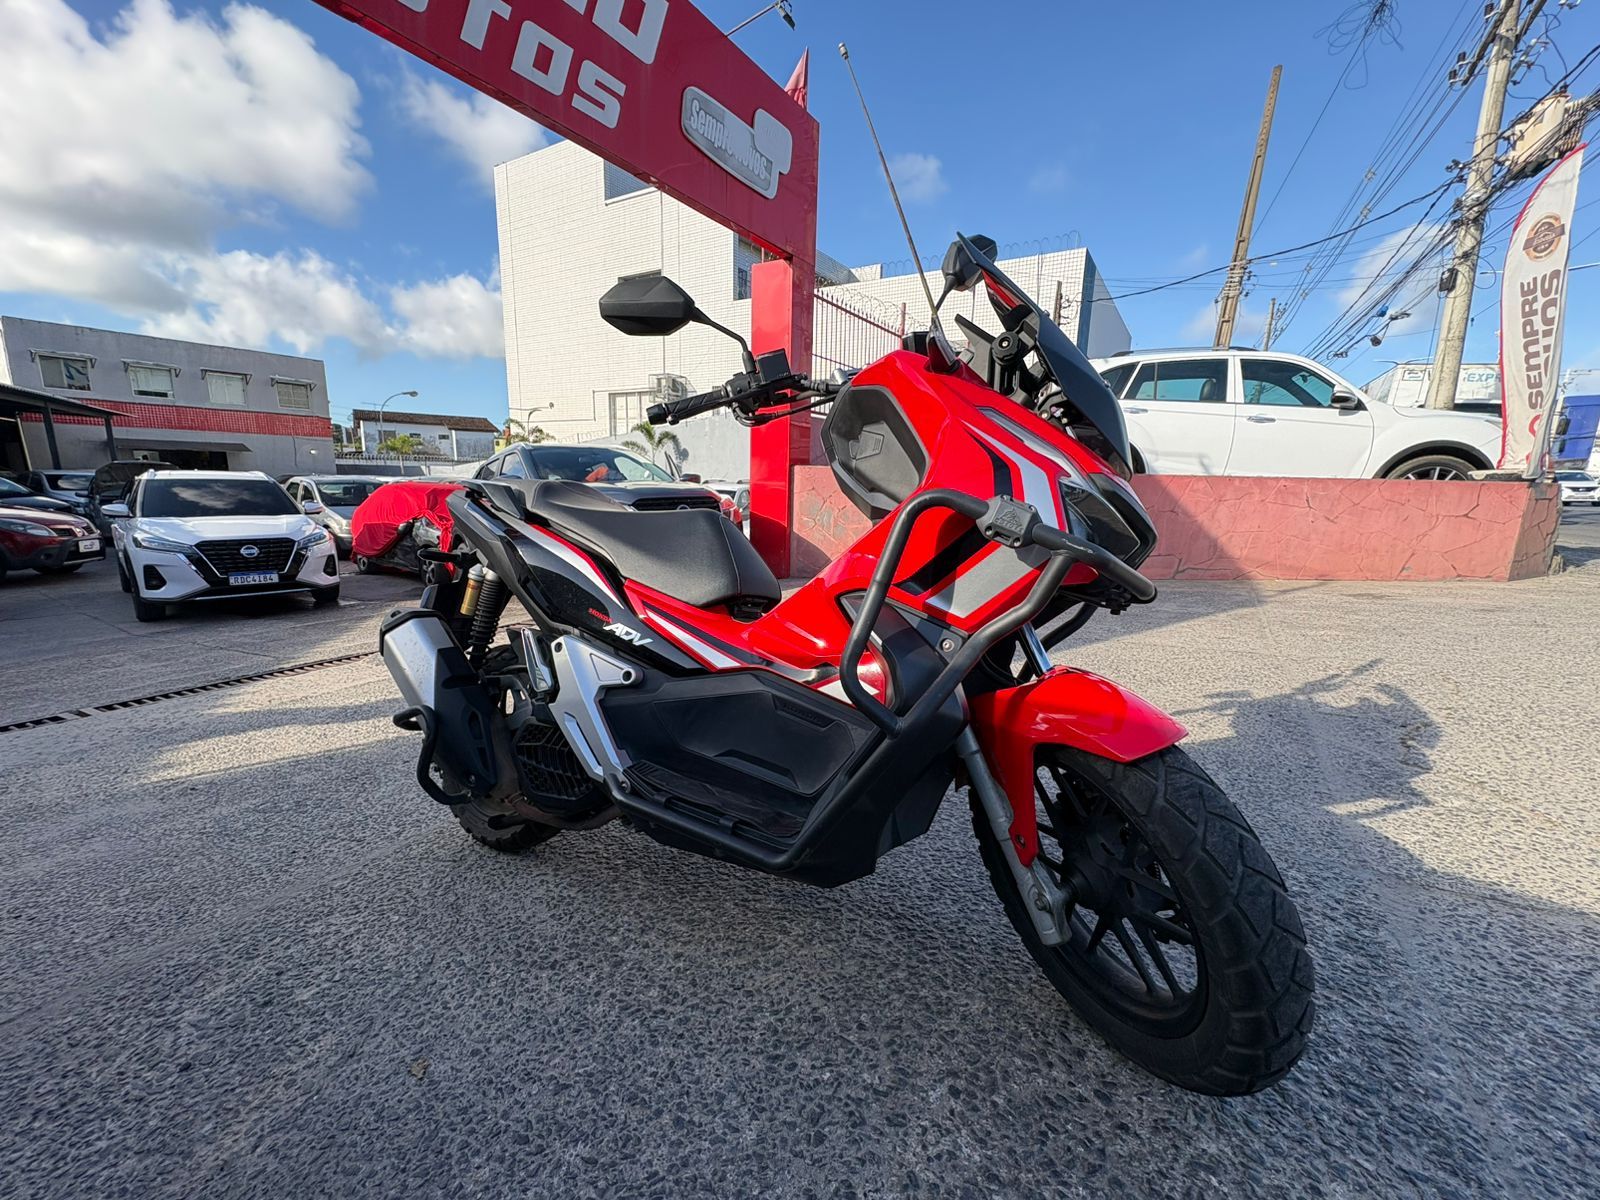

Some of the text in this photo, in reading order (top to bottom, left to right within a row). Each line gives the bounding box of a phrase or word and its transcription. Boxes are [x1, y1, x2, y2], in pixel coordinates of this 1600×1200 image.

[1520, 276, 1545, 410] SEMPRE
[587, 608, 612, 624] HONDA
[602, 622, 653, 646] ADV
